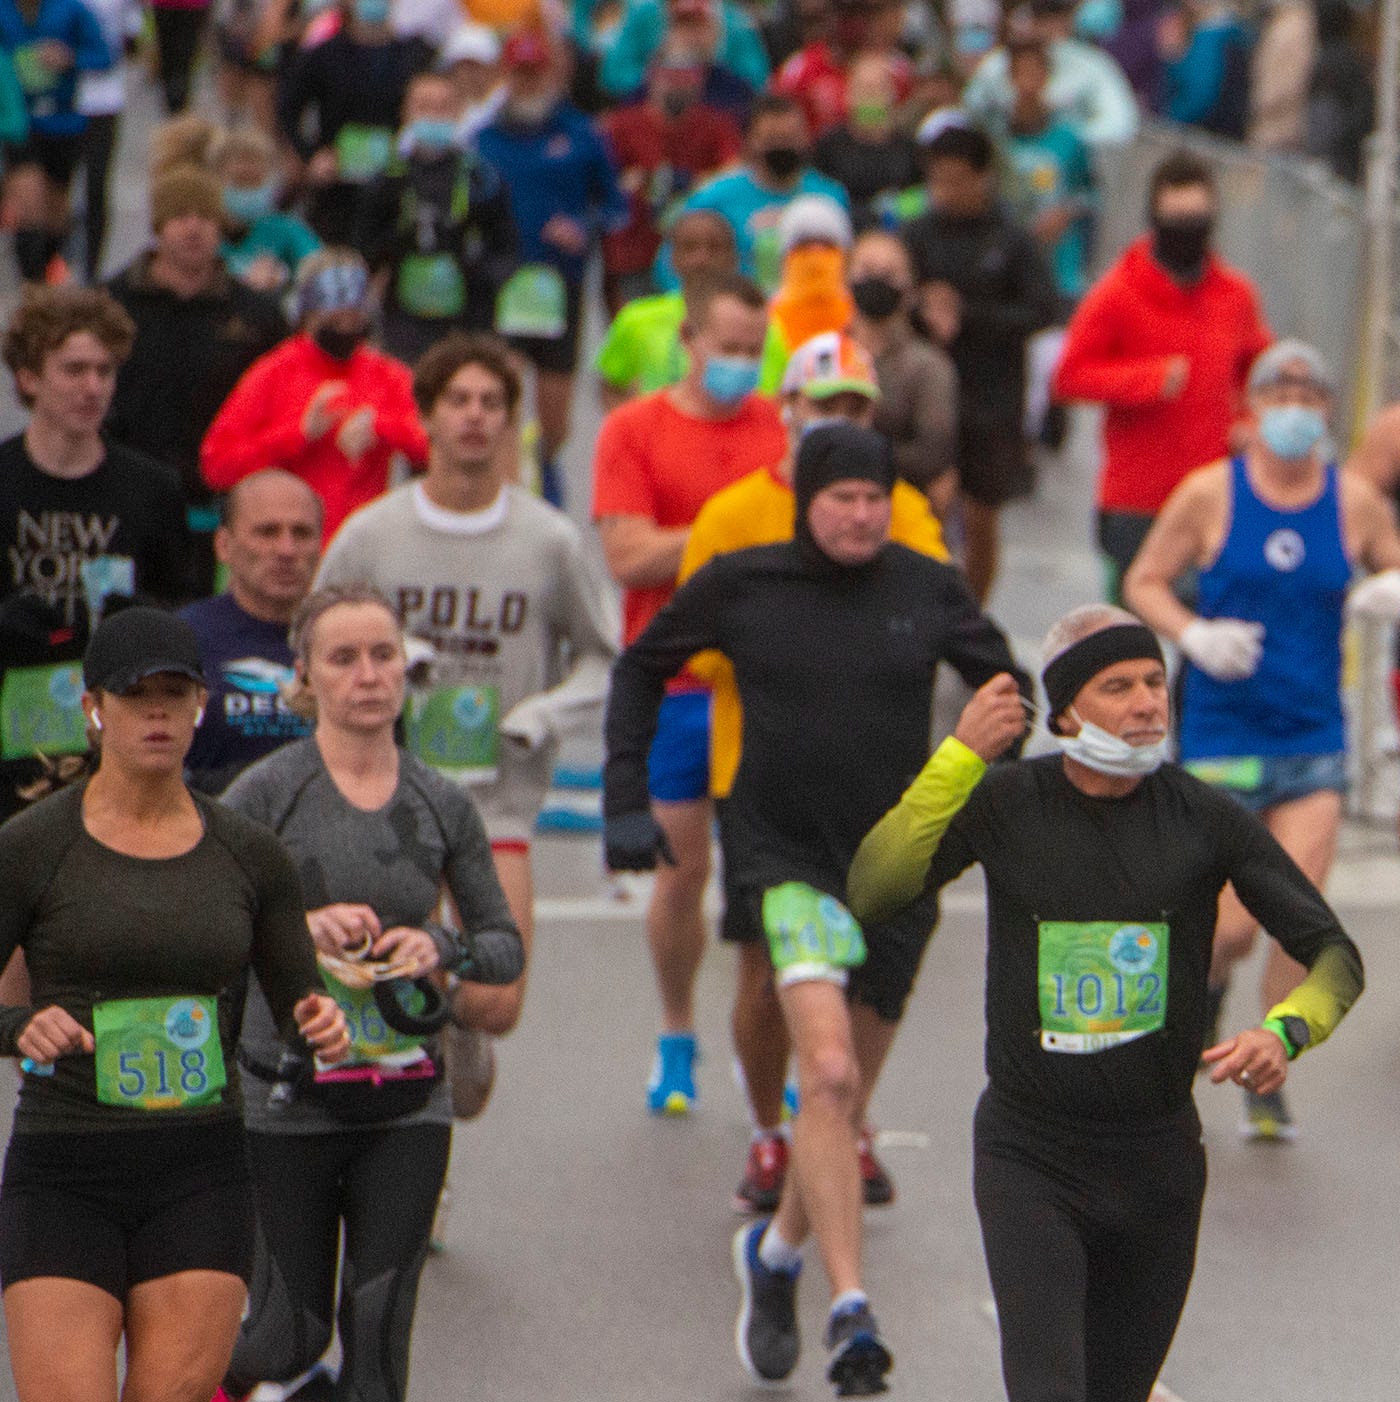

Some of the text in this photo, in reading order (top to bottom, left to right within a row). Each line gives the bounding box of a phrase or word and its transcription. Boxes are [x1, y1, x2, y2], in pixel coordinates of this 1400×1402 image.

[17, 509, 121, 551] NEW
[398, 586, 527, 637] POLO
[1052, 973, 1161, 1017] 1012
[118, 1047, 208, 1098] 518
